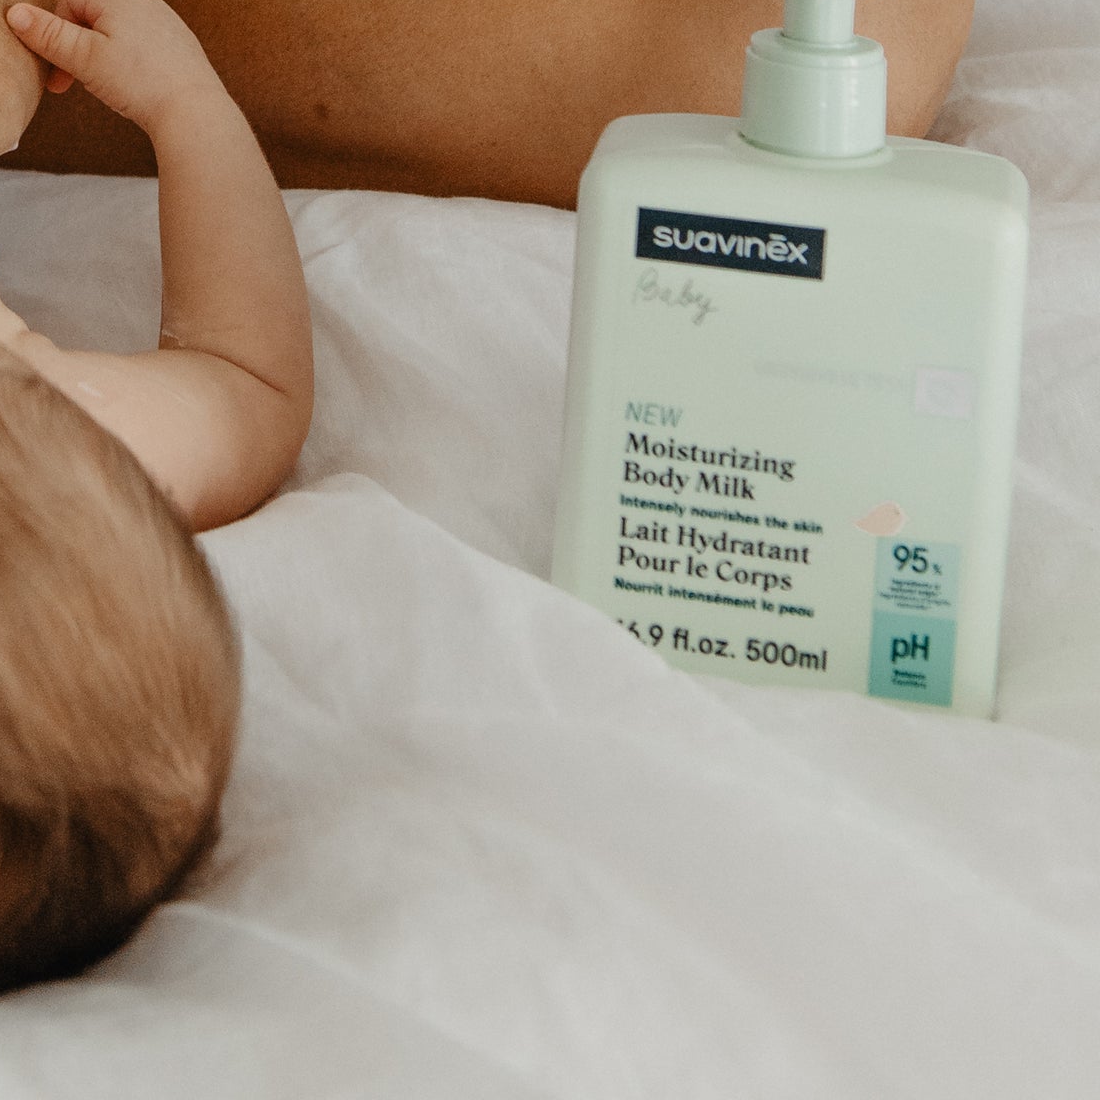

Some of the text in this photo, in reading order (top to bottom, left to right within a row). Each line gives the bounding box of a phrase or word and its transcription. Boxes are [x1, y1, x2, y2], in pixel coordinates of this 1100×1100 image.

[632, 266, 719, 325] Baby
[624, 401, 683, 428] NEW
[626, 432, 796, 482] Moisturizing
[624, 460, 756, 500] Body Milk
[620, 494, 823, 535] Intensely nourishes the skin
[620, 516, 811, 564] Lait Hydratant
[618, 545, 793, 592] Pour le Corps
[614, 576, 664, 597] Nourrit
[778, 603, 814, 618] peau
[745, 638, 828, 672] 500ml
[891, 633, 929, 664] pH
